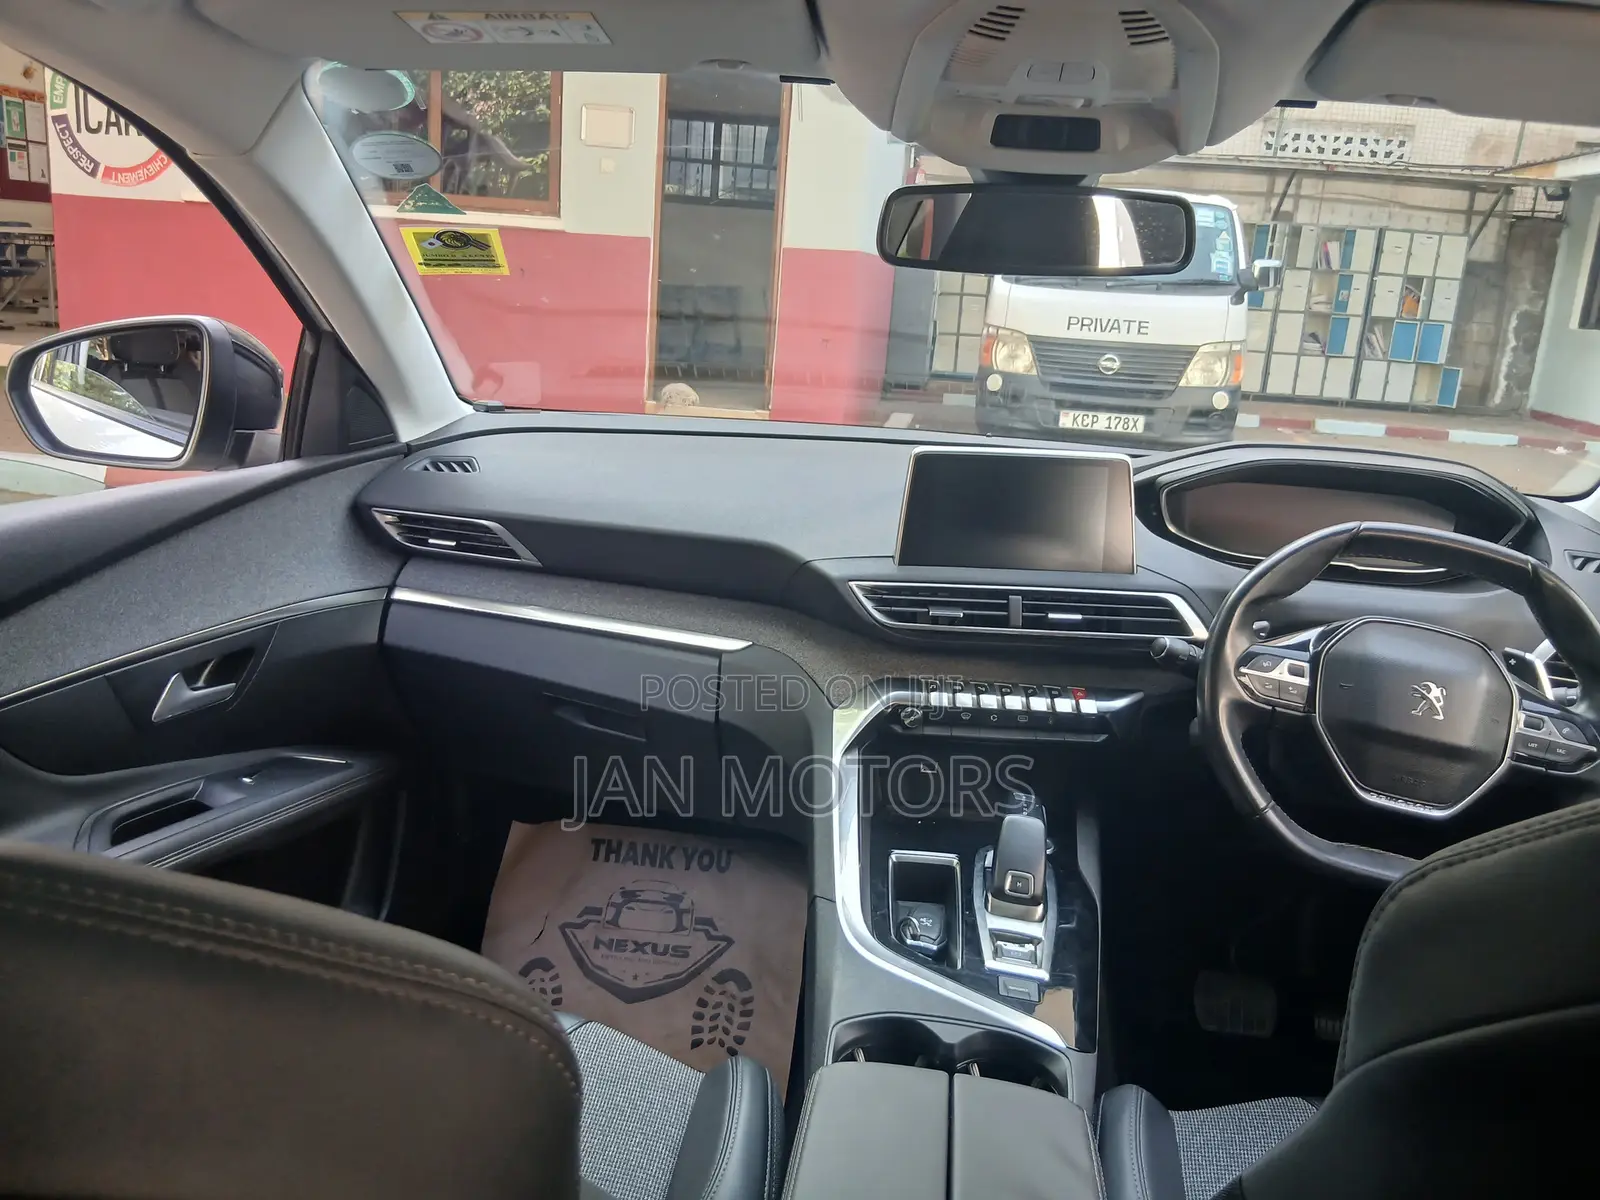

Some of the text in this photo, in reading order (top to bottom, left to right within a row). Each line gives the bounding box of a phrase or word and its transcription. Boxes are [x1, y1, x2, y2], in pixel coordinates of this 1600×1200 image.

[55, 122, 95, 173] RESPECT
[1066, 316, 1150, 336] PRIVATE
[1104, 415, 1140, 432] 178X
[590, 838, 733, 874] THANK YOU
[593, 935, 692, 959] NEXUS
